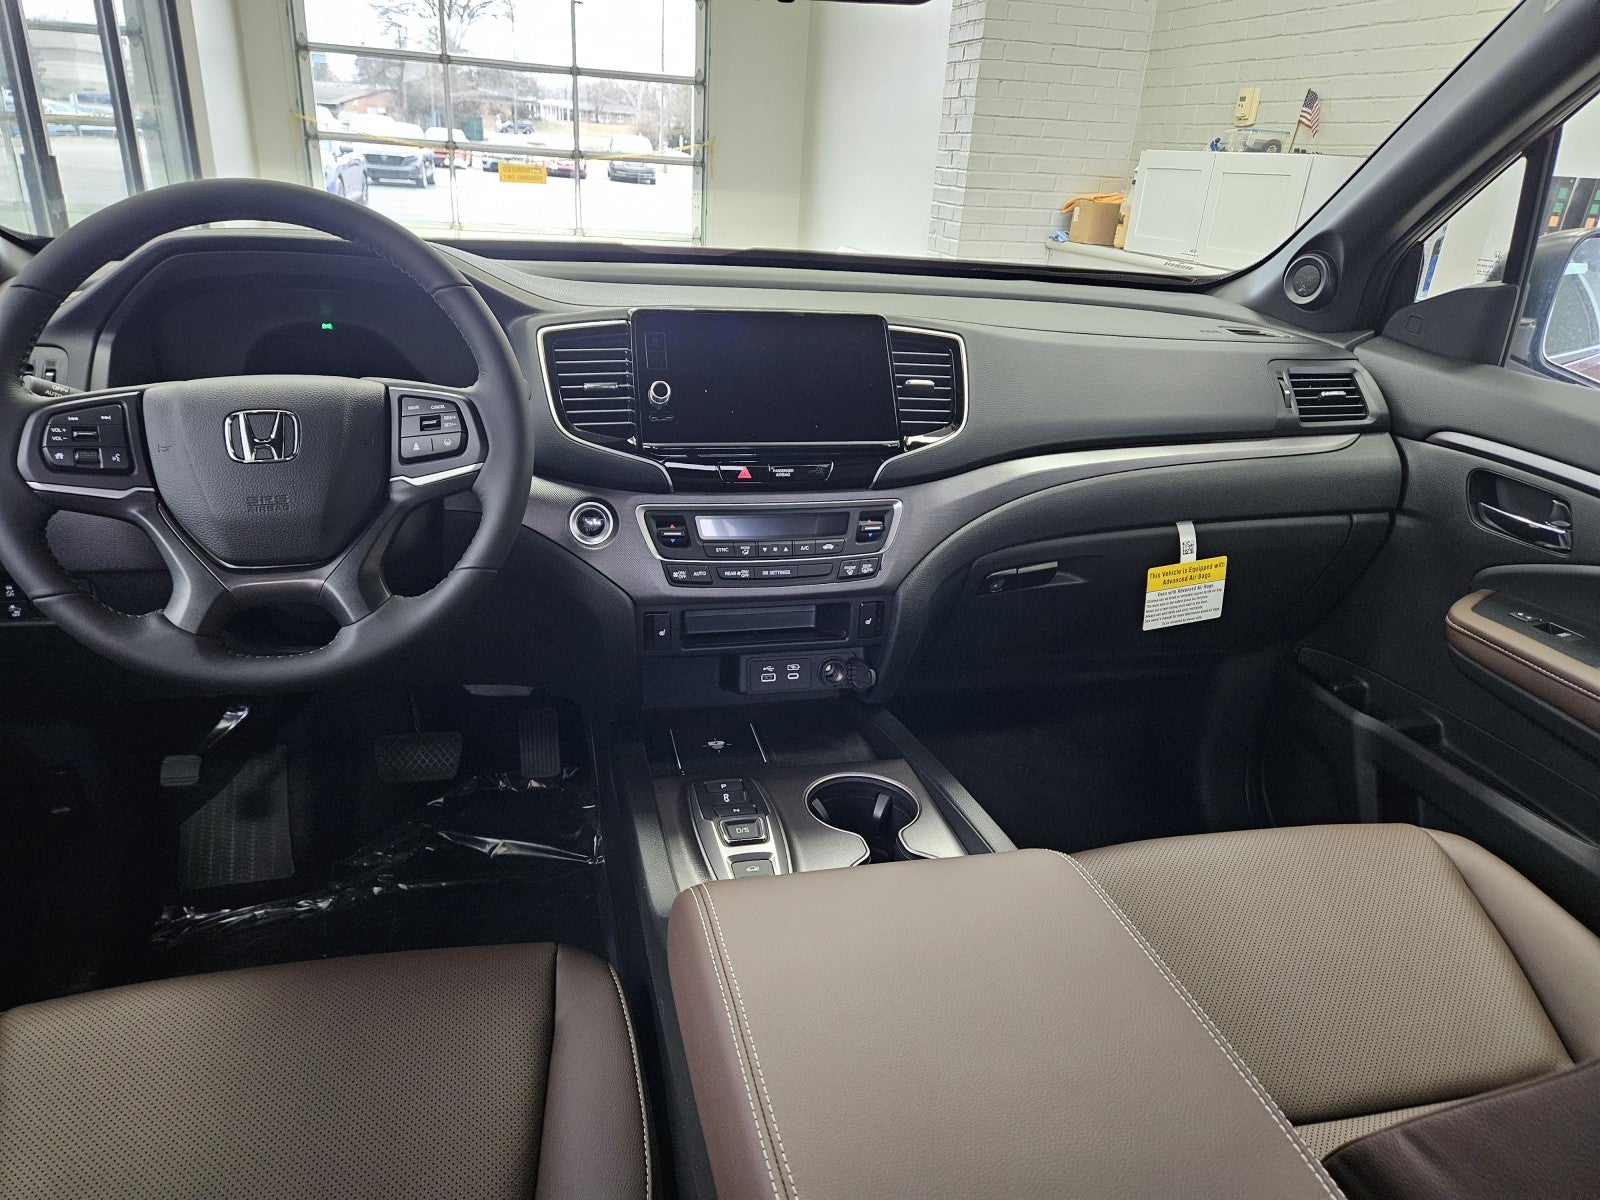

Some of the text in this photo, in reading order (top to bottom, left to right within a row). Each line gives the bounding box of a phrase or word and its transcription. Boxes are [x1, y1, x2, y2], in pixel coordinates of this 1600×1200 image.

[45, 390, 63, 398] AUTO
[1162, 569, 1182, 577] Vehicle
[1189, 564, 1213, 573] Equipped
[1163, 577, 1188, 585] Advanced
[1197, 572, 1211, 580] Bags
